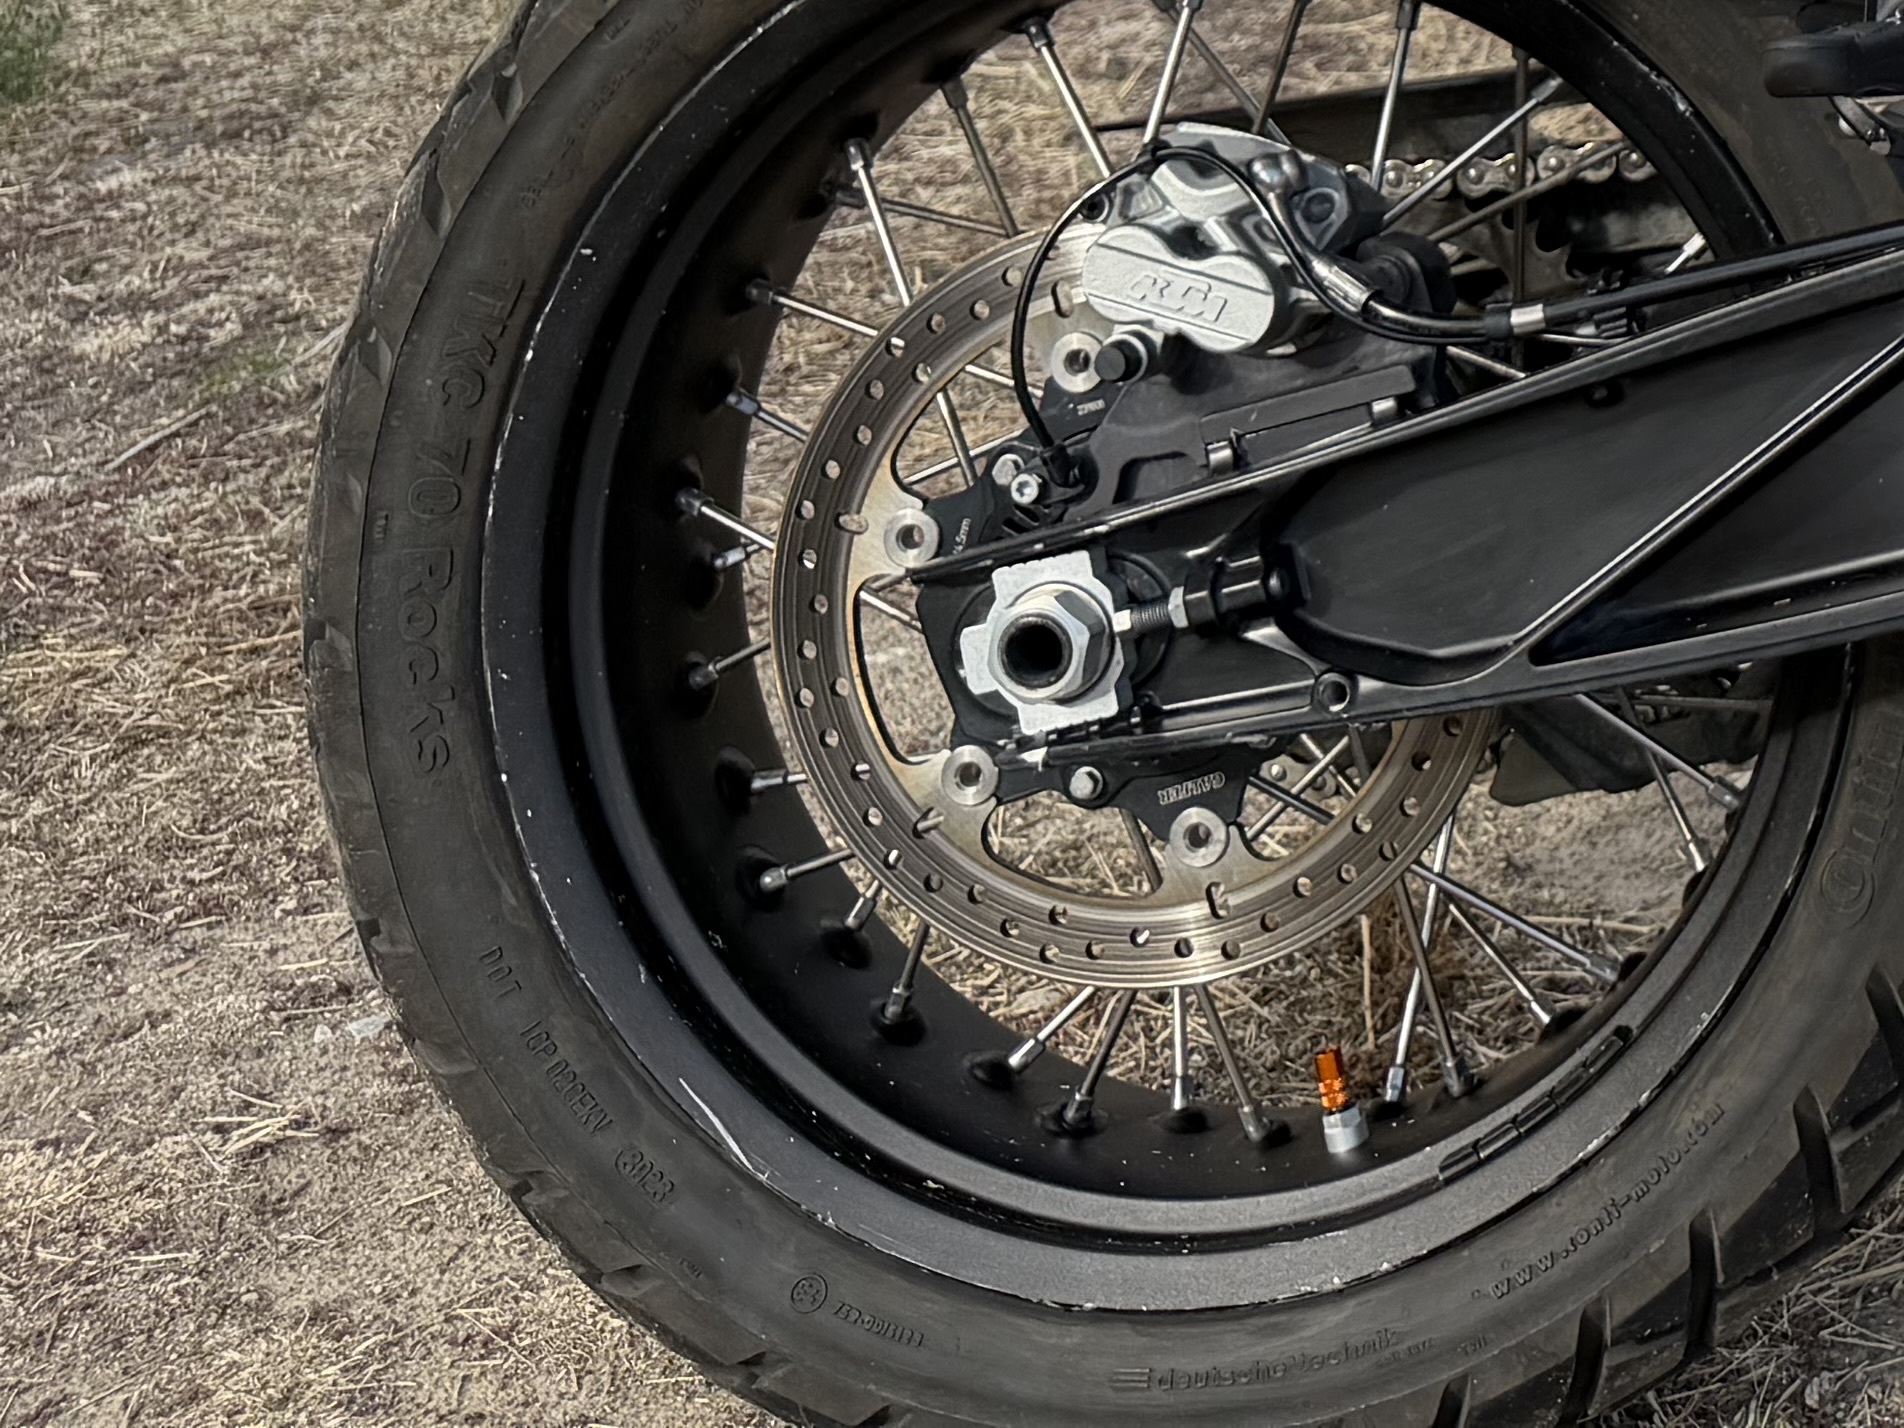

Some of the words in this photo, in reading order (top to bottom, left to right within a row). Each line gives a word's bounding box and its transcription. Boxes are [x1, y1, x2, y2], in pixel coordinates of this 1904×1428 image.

[1129, 268, 1229, 324] KTM
[408, 438, 471, 518] 70
[479, 945, 523, 998] DOT
